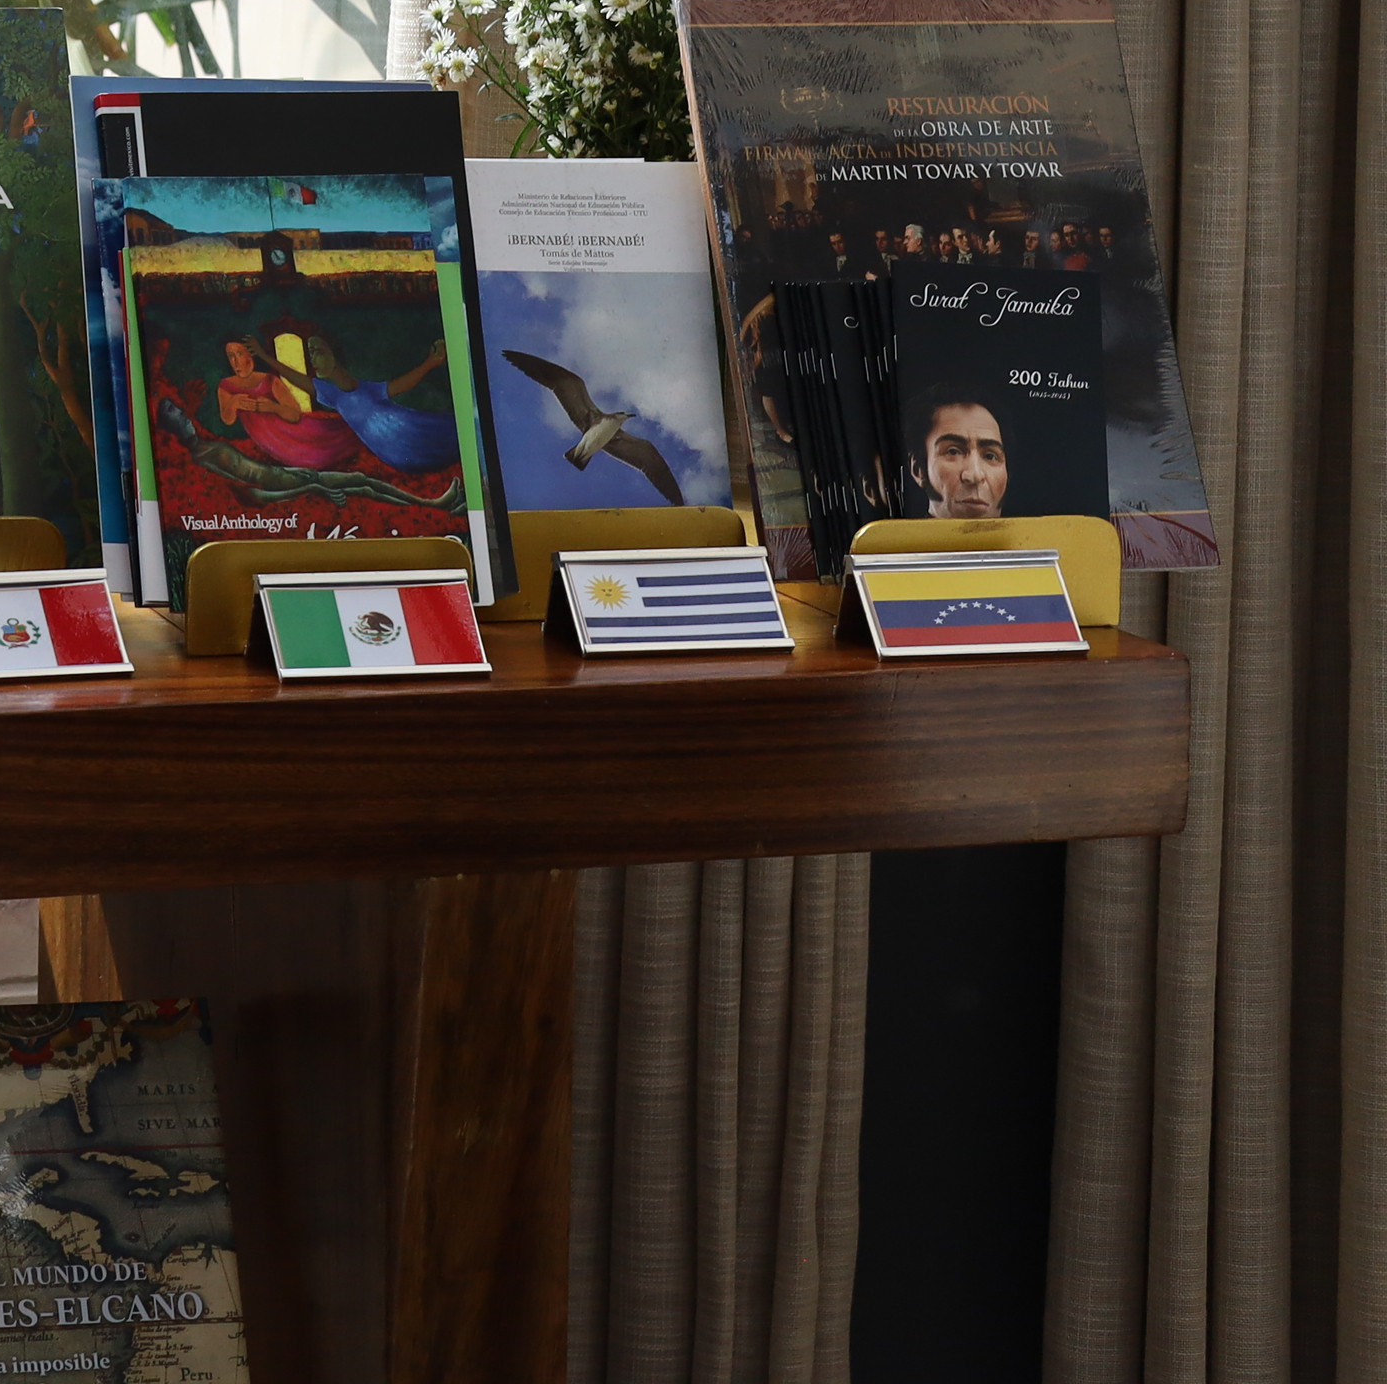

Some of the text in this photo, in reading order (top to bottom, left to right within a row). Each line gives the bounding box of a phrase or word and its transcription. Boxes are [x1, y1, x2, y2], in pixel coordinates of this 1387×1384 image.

[886, 91, 1051, 117] RESTAURACIÓN
[893, 129, 906, 137] DE
[921, 121, 973, 137] OBRA
[979, 120, 1003, 136] DE
[1008, 119, 1054, 136] ARTE
[828, 143, 877, 160] ACTA
[896, 141, 1058, 159] INDEPENDENCIA
[816, 161, 1064, 182] DE MARTIN TOVAR Y TOVAR
[550, 201, 578, 209] Nacional
[588, 201, 620, 209] Educación
[508, 233, 645, 246] ¡BERNABÉ! ¡BERNABÉ!
[539, 248, 615, 258] Tomás de Mattos
[910, 281, 1081, 327] Surat Jamaika
[1009, 369, 1090, 390] 200 Tahun
[181, 513, 298, 534] Visual Anthology of
[137, 1084, 196, 1097] MARIS
[138, 1119, 175, 1132] SIVE
[12, 1264, 108, 1288] MUNDO
[114, 1262, 148, 1282] DE
[11, 1352, 111, 1376] imposible
